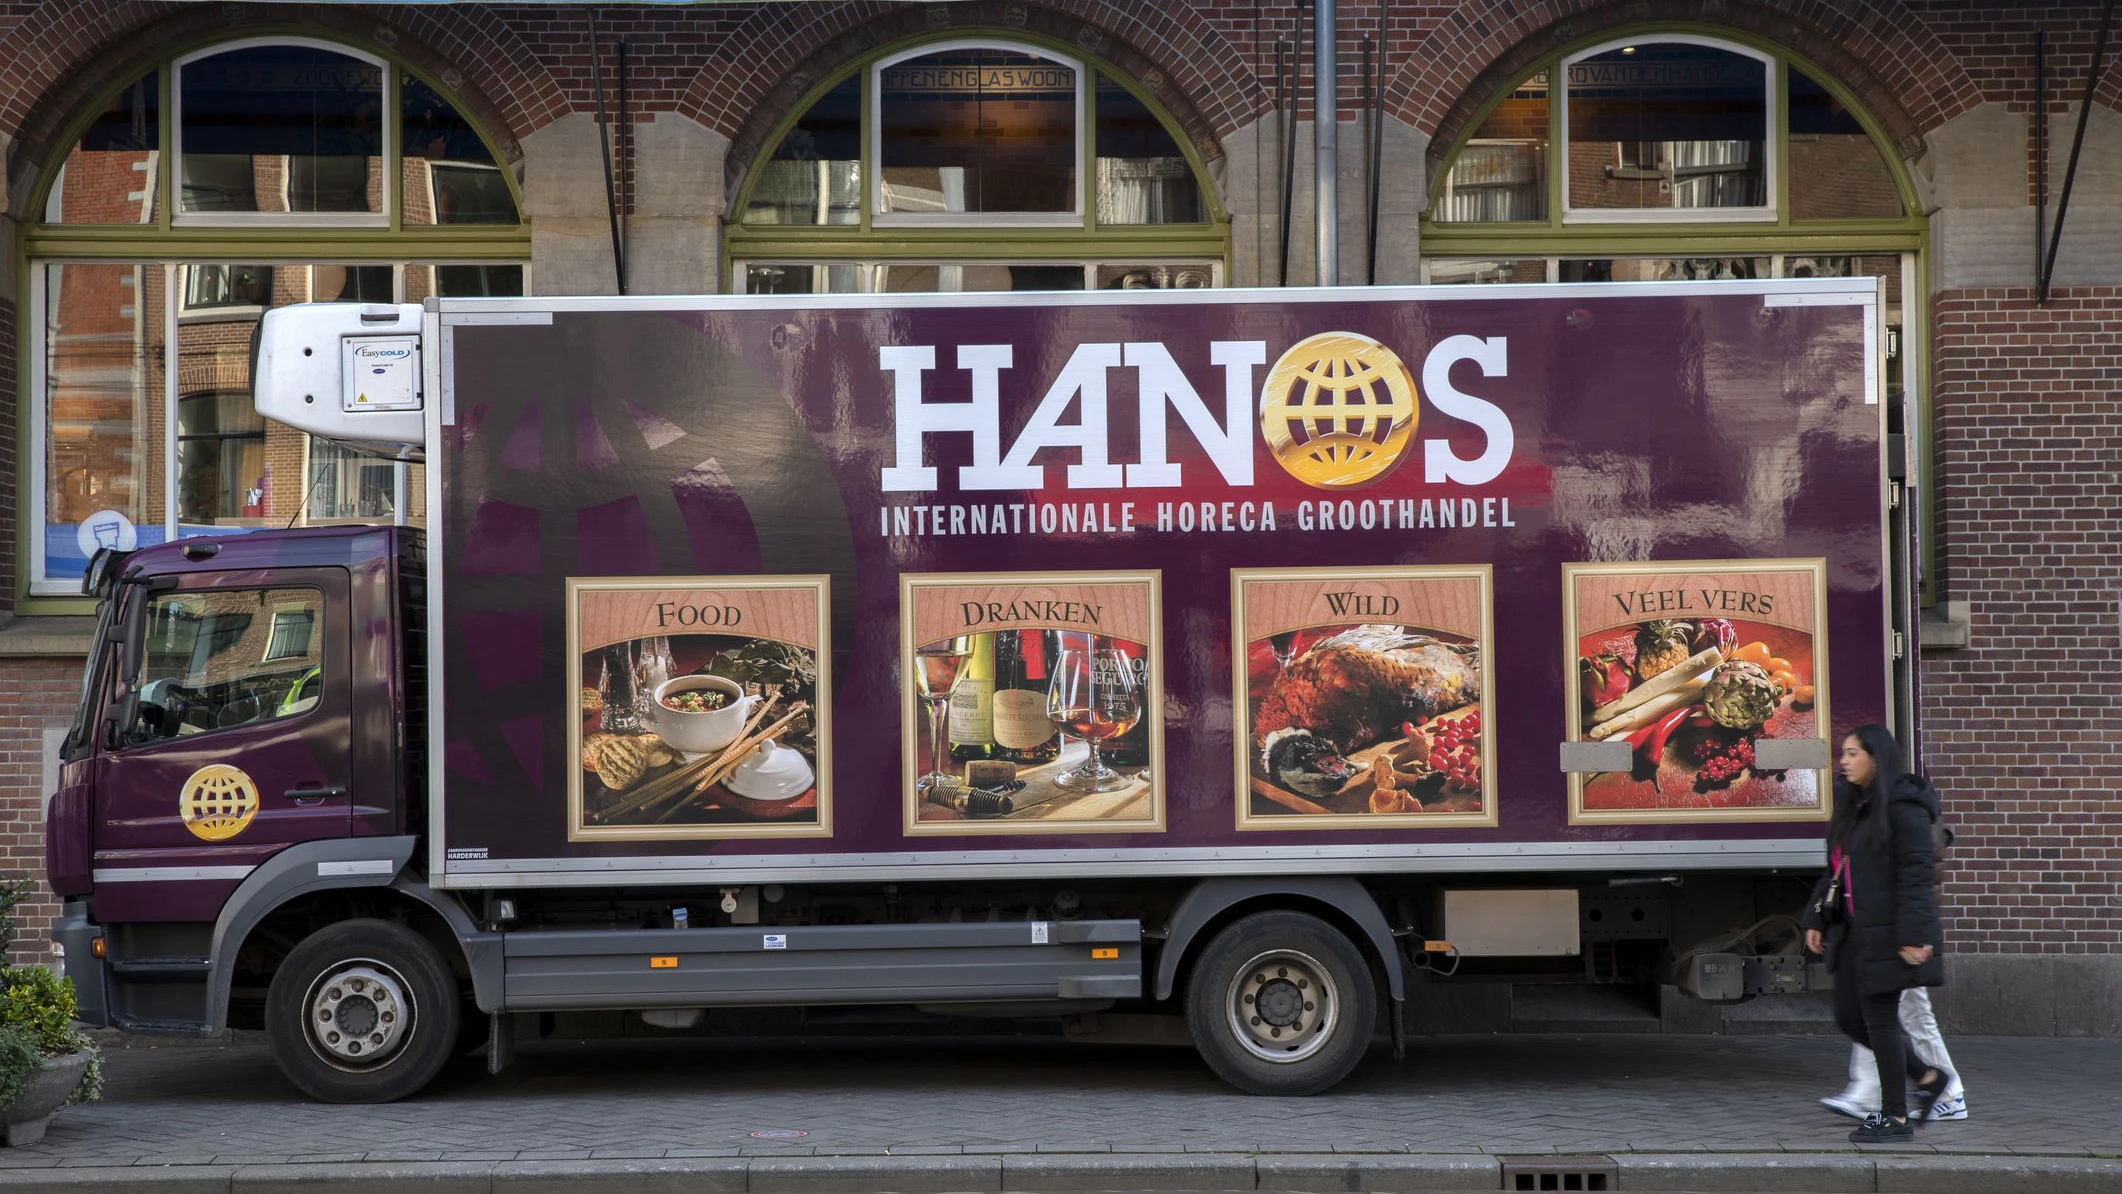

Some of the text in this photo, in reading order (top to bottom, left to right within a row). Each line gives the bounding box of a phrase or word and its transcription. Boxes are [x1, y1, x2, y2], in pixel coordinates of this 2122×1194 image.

[362, 348, 404, 358] EasyCOLD
[879, 330, 1514, 492] HANOS
[881, 497, 1516, 537] INTERNATIONALE HORECA GROOTHANDEL
[656, 601, 741, 627] FOOD
[960, 600, 1103, 627] DRANKEN
[1323, 591, 1400, 617] WILD
[1612, 589, 1774, 616] VEEL VERS
[448, 852, 488, 860] HARDERWIJK
